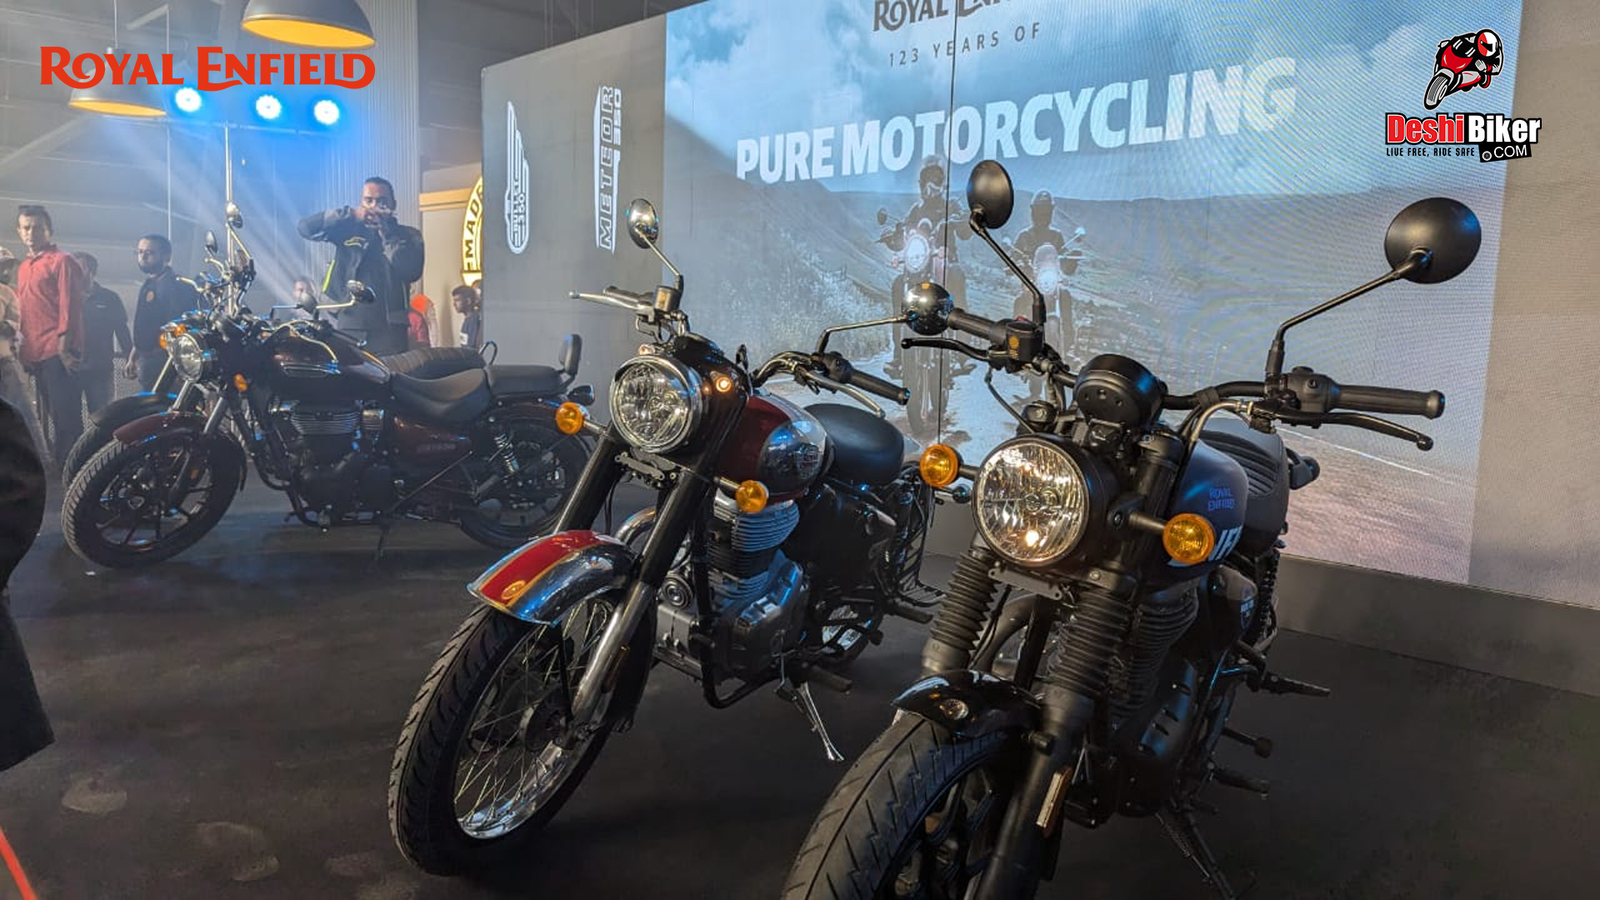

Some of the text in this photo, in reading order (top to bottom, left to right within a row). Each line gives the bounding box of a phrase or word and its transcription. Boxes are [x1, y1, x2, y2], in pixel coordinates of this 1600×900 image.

[873, 0, 949, 31] ROYAL
[889, 22, 1040, 67] 123 YEARS OF
[613, 88, 622, 146] 350
[737, 57, 1297, 183] PURE MOTORCYCLING
[600, 86, 613, 250] METEOR
